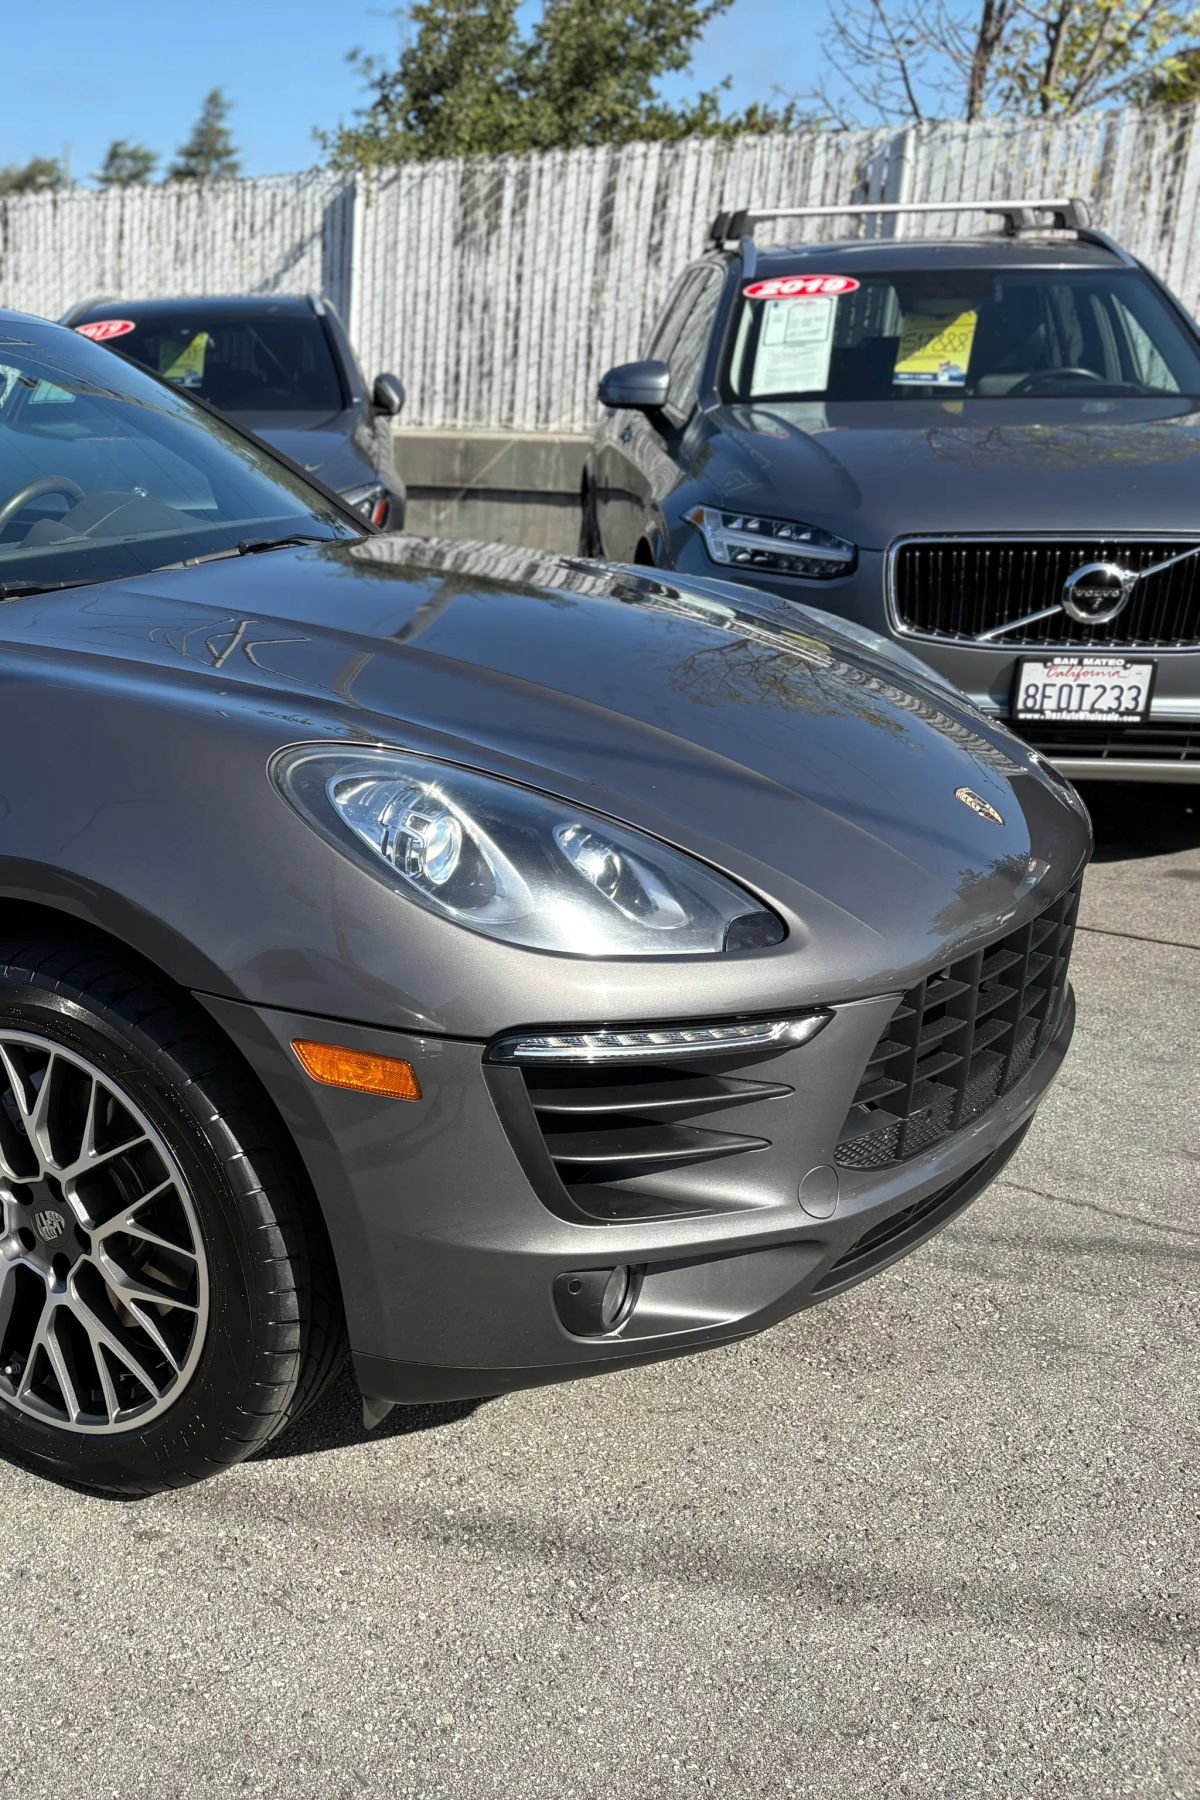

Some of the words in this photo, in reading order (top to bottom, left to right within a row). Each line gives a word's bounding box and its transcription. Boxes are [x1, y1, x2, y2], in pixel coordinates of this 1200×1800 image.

[1053, 657, 1079, 666] SAN
[1083, 658, 1126, 667] MATEO
[1046, 666, 1129, 682] California
